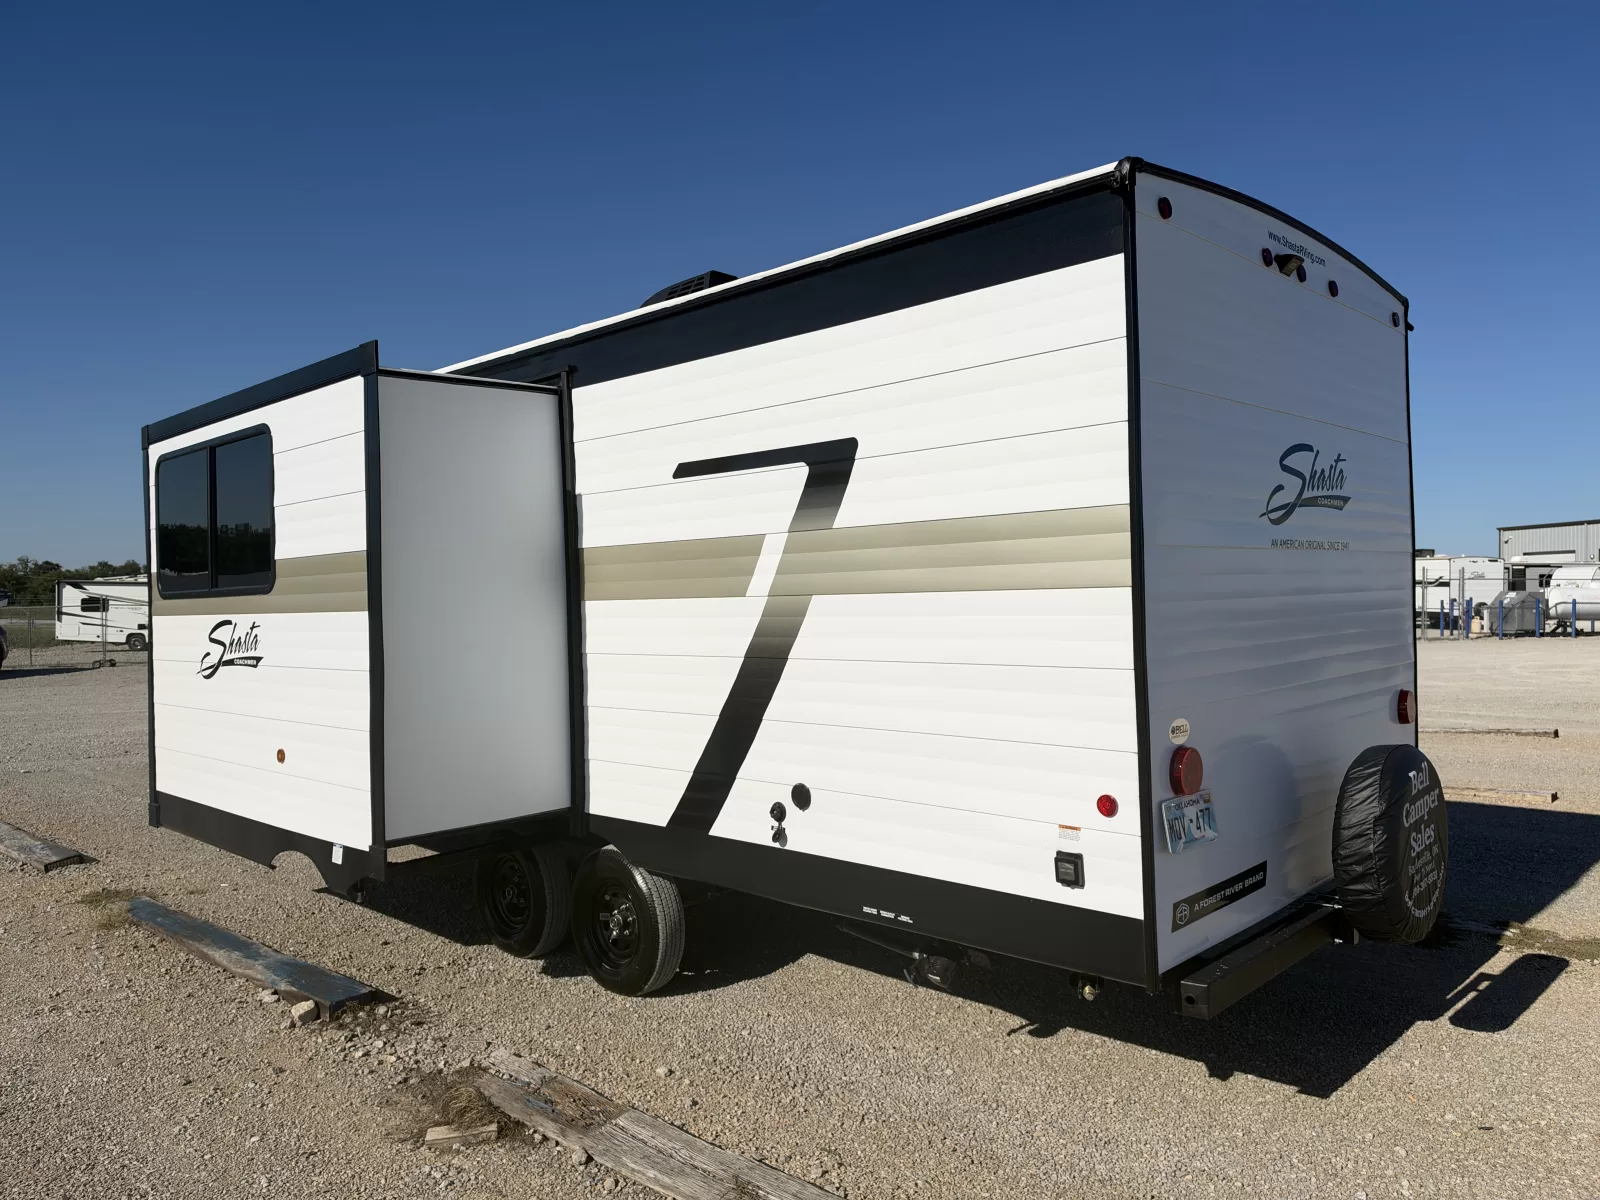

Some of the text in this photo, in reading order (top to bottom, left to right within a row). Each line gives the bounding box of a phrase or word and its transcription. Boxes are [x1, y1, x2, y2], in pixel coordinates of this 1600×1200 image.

[1268, 230, 1326, 267] www.ShastaRVing.com
[1259, 443, 1347, 525] Shasta
[1317, 497, 1344, 507] COACHMEN
[1271, 539, 1279, 549] AN
[1279, 539, 1305, 549] AMERICAN
[1305, 540, 1327, 550] ORIGINAL
[1327, 541, 1340, 551] SINCE
[196, 619, 261, 679] Shasta
[233, 658, 257, 666] COACHMEN
[1175, 724, 1189, 735] BELL
[1408, 761, 1430, 796] Bell
[1175, 798, 1201, 812] OKLAHOMA
[1403, 788, 1440, 828] Camper
[1410, 824, 1435, 857] Sales
[1194, 871, 1264, 912] A FOREST RIVER BRAND
